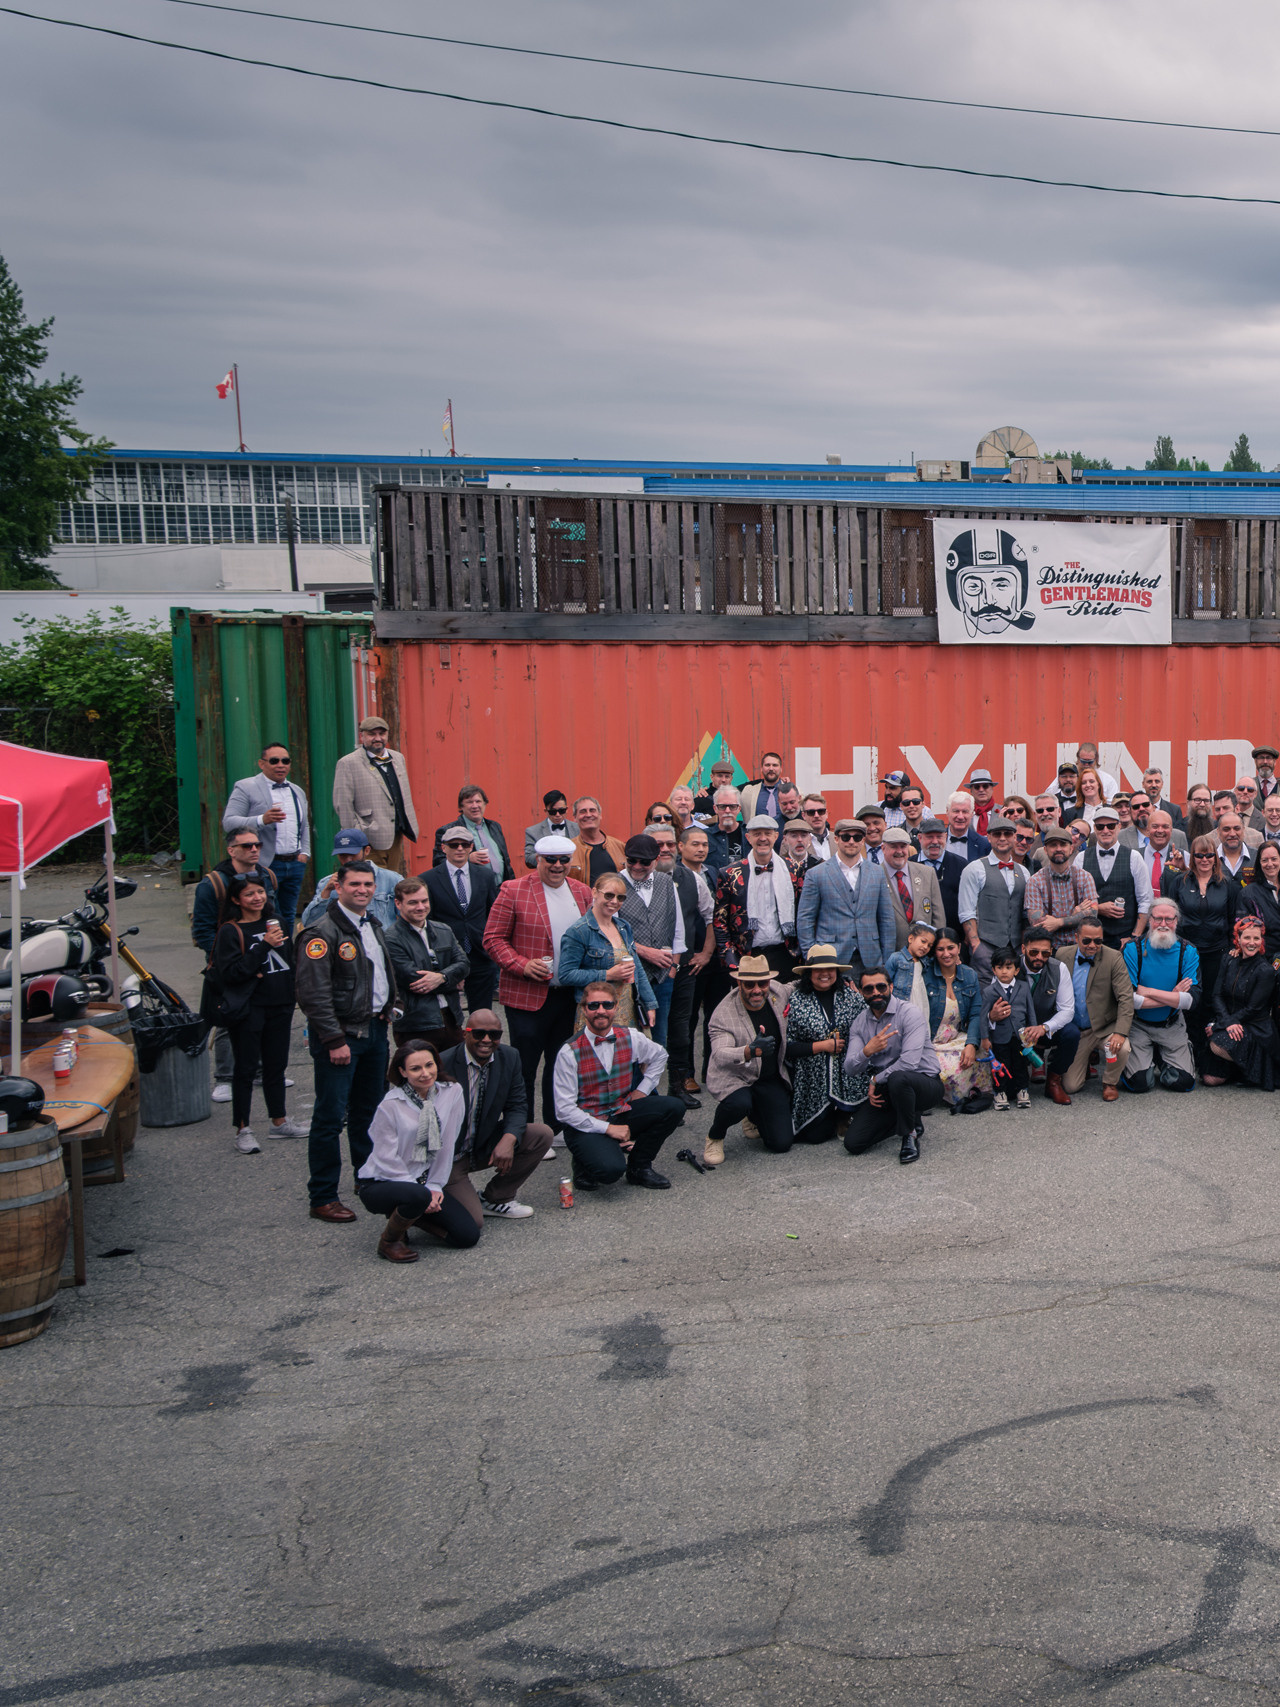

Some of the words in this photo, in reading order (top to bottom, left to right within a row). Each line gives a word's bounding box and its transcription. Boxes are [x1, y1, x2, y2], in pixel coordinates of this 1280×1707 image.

[1064, 561, 1081, 569] THE
[1036, 565, 1162, 589] Distinguished
[1040, 586, 1153, 608] GENTLEMAN'S
[1067, 600, 1123, 617] Ride
